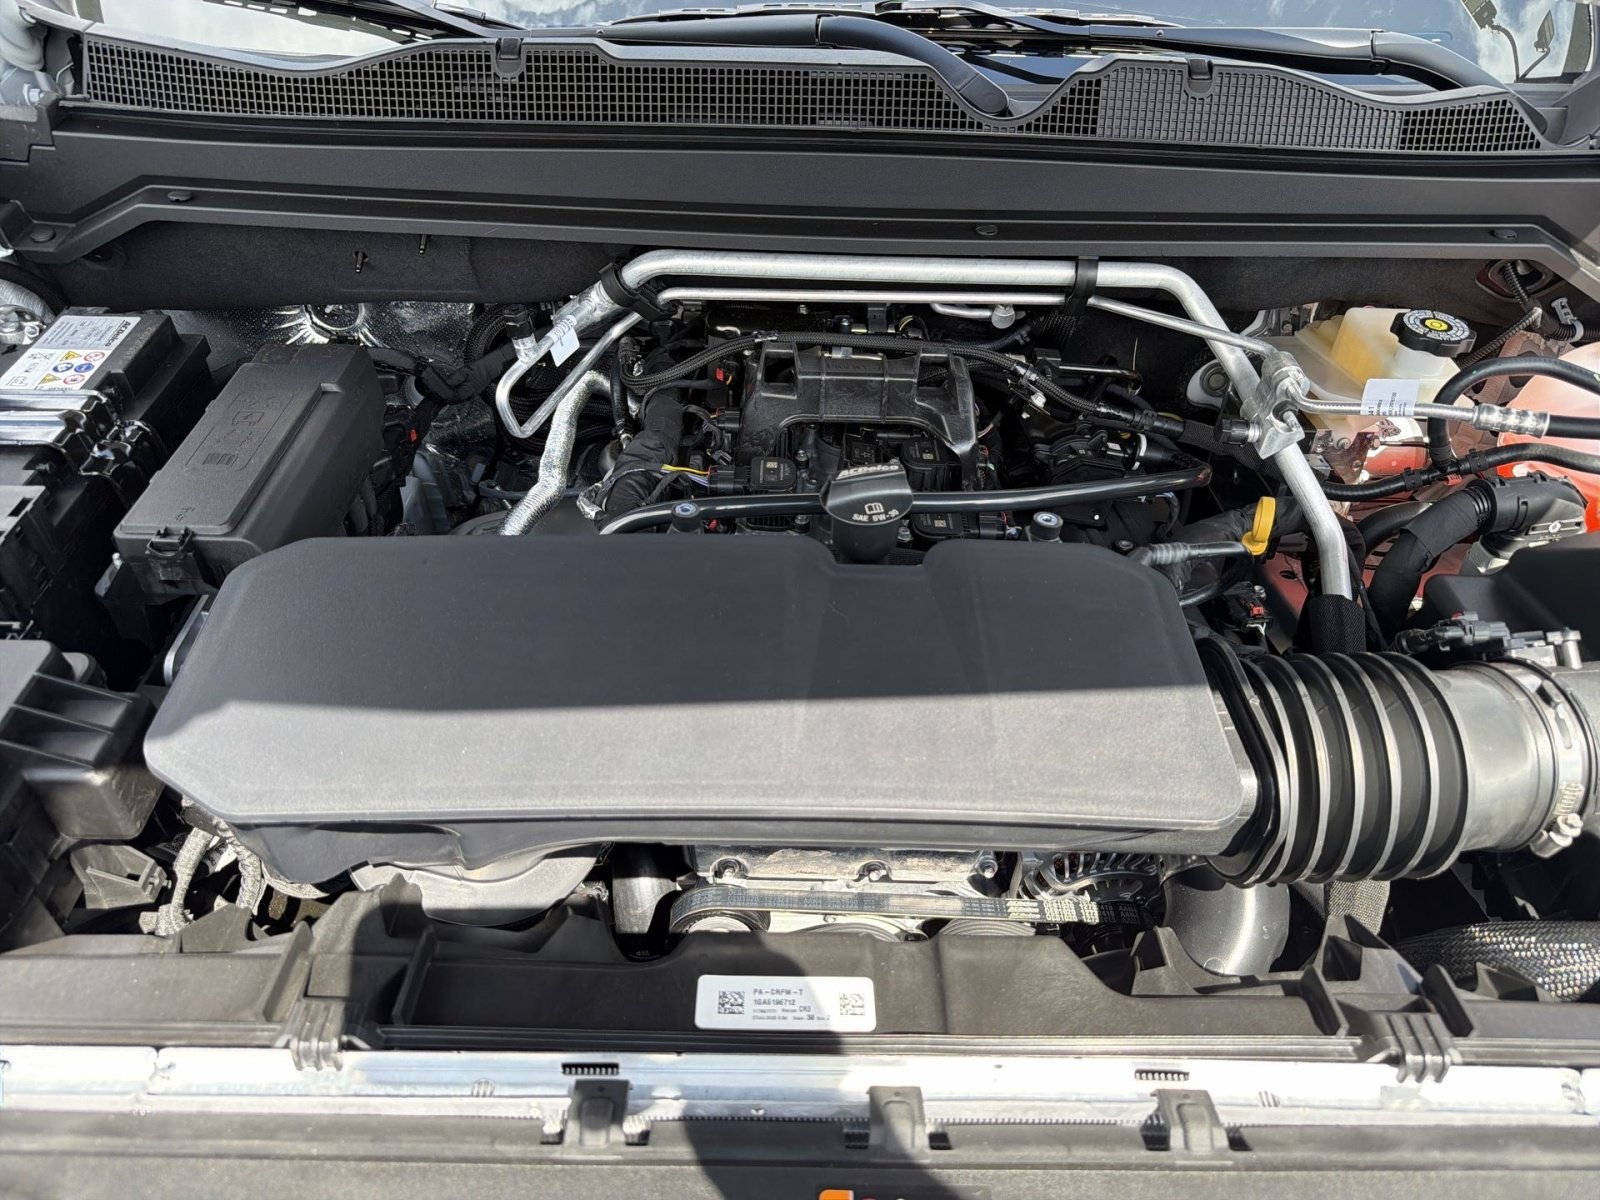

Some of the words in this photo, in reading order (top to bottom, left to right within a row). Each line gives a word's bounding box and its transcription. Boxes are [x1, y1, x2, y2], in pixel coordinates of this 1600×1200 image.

[105, 321, 132, 347] ACDelco
[836, 464, 900, 480] ACDelco
[852, 513, 869, 522] SAE
[872, 508, 900, 522] 5W-30
